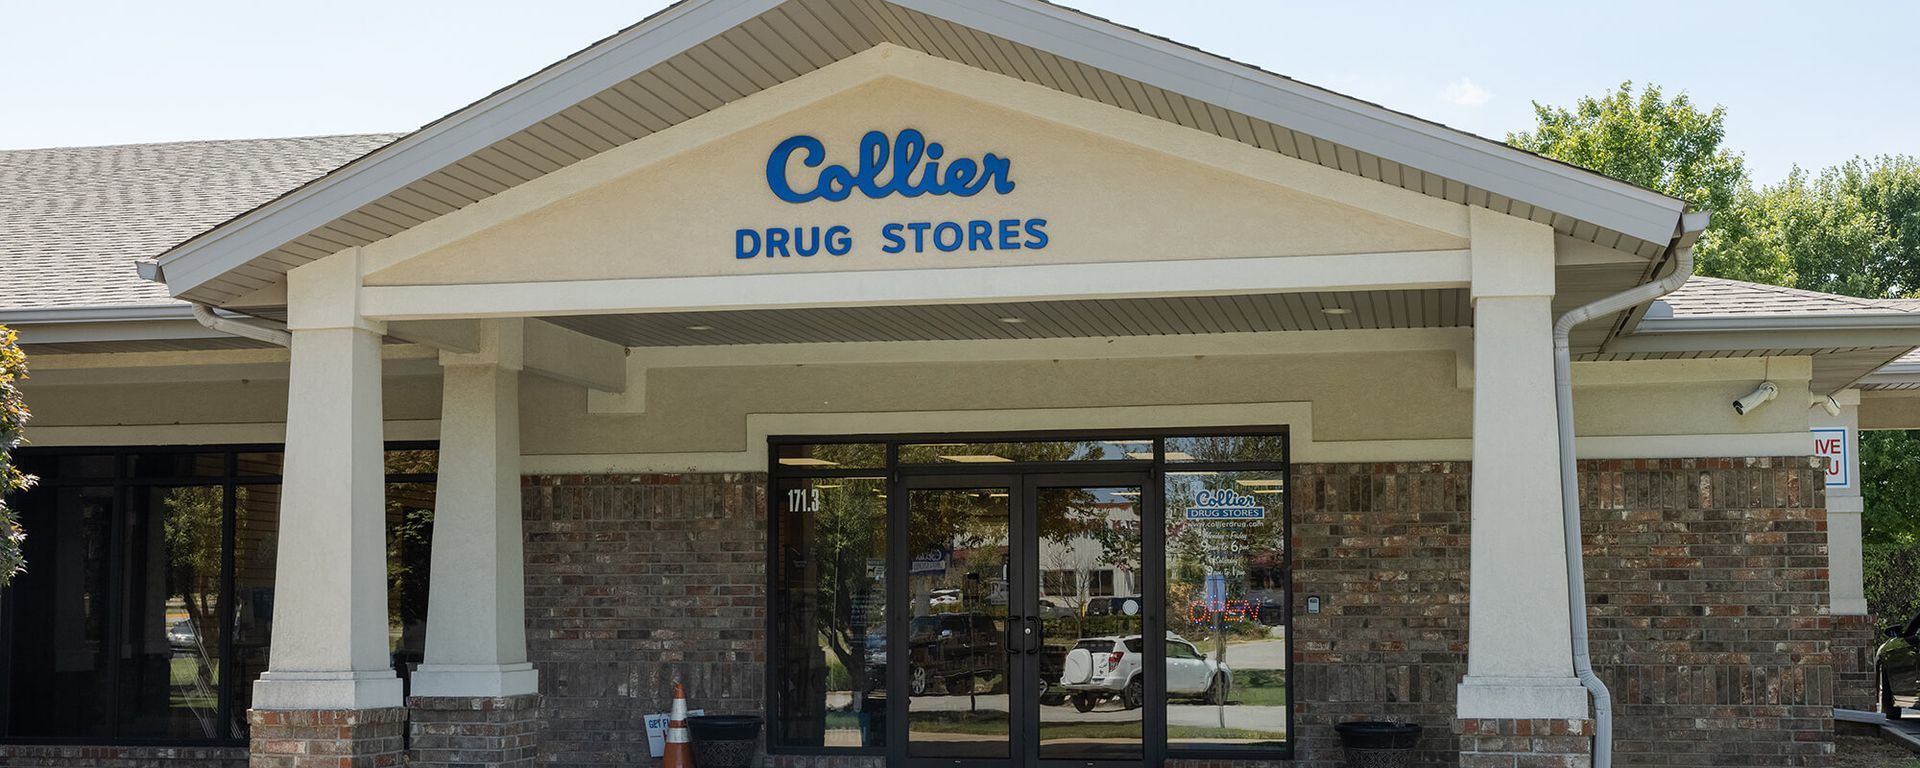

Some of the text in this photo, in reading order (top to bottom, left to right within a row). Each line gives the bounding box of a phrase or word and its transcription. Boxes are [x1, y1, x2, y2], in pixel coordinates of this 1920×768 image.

[766, 128, 1015, 204] Collier
[735, 218, 1049, 259] DRUG STORES
[788, 489, 820, 512] 171.3
[1196, 490, 1255, 507] Collier
[1190, 599, 1260, 622] OPEN
